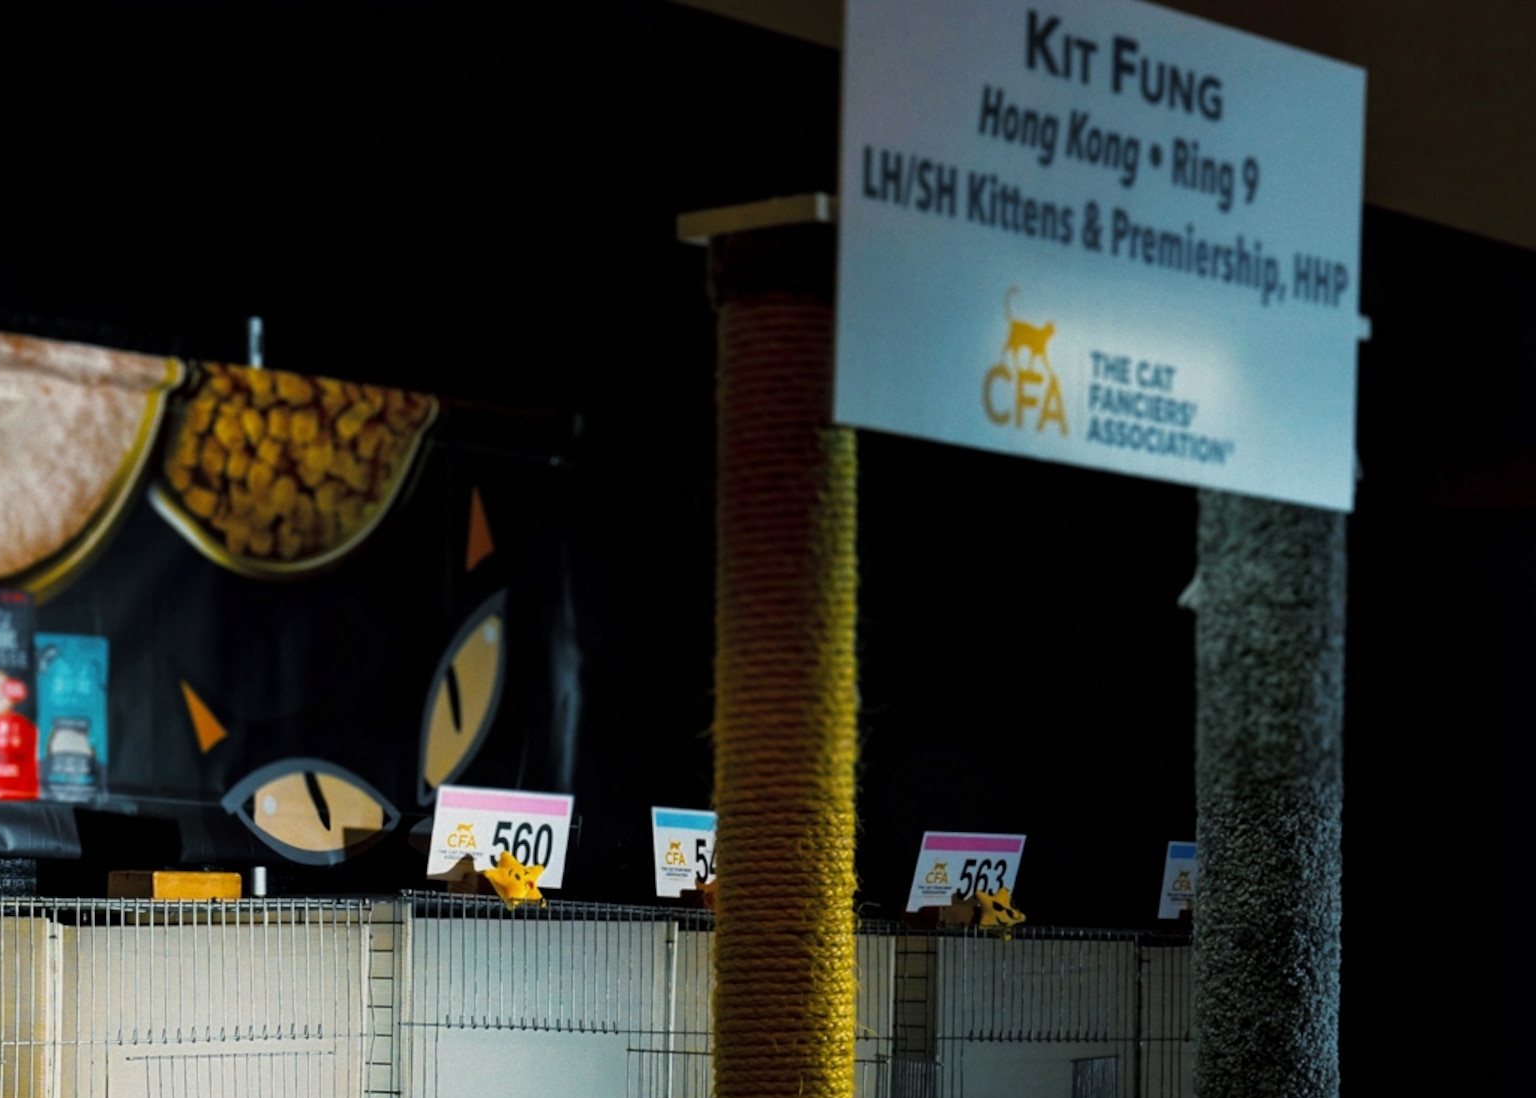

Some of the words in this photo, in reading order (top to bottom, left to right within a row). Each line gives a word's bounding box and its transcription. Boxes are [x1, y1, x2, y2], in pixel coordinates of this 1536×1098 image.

[977, 83, 1059, 168] Hong
[1065, 108, 1141, 188] Kong
[1171, 136, 1235, 214] Ring
[1242, 155, 1260, 206] 9
[862, 144, 959, 219] LH/SH
[966, 171, 1074, 245] Kittens
[1081, 200, 1103, 254] &
[1110, 207, 1287, 307] Premiership,
[1293, 252, 1350, 307] HHP
[1089, 350, 1132, 385] THE
[1135, 359, 1177, 391] CAT
[981, 362, 1069, 436] CFA
[446, 834, 478, 850] CFA
[489, 821, 554, 870] 560
[665, 852, 687, 866] CFA
[925, 872, 949, 884] CFA
[956, 858, 1008, 899] 563
